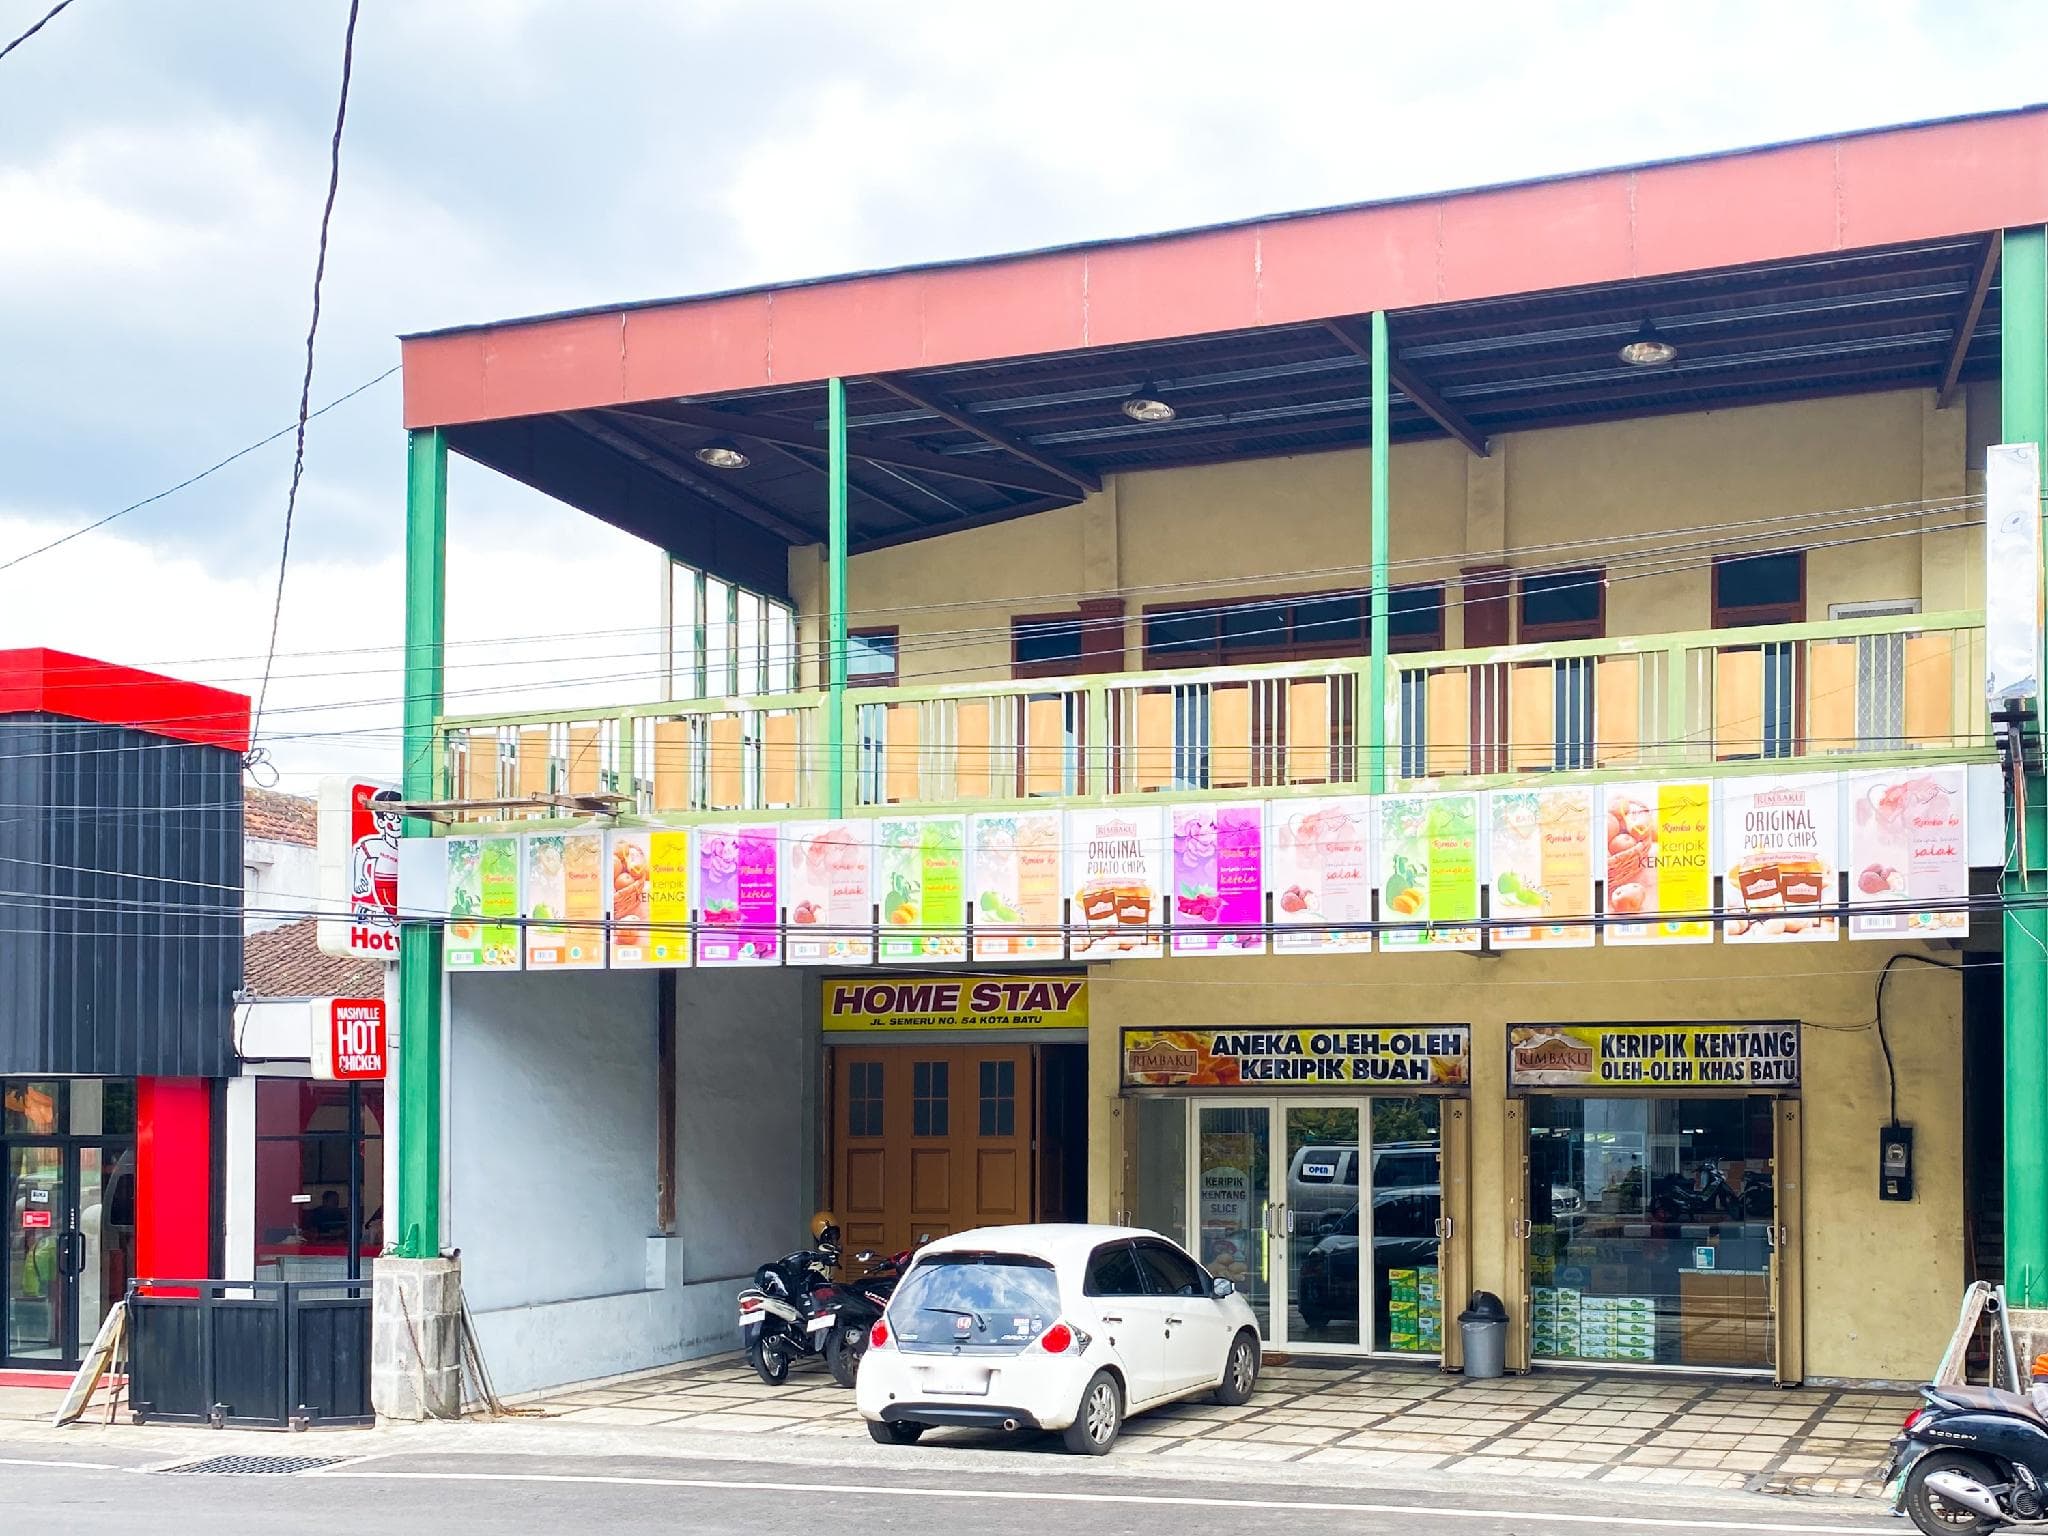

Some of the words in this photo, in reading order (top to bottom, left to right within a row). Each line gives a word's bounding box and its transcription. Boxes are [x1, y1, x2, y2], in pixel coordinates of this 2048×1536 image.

[1745, 809, 1816, 831] ORIGINAL
[1662, 840, 1705, 853] keripik
[1744, 833, 1783, 849] POTATO
[1787, 831, 1817, 848] CHIPS
[1088, 840, 1145, 859] ORIGINAL
[1911, 844, 1958, 858] salak
[1087, 860, 1119, 874] POTATO
[1121, 860, 1146, 874] CHIPS
[1638, 854, 1706, 868] KENTANG
[1326, 867, 1362, 881] salak
[635, 891, 686, 902] KENTANG
[832, 984, 961, 1015] HOME
[970, 982, 1084, 1013] STAY
[336, 1007, 380, 1020] NASHVILLE
[889, 1016, 936, 1025] SEMERU
[938, 1016, 958, 1025] NO.
[961, 1016, 977, 1025] 54
[979, 1016, 1010, 1024] KOTA
[1012, 1015, 1043, 1024] BATU
[337, 1020, 381, 1055] HOT
[1601, 1034, 1688, 1058] KERIPIK
[1694, 1031, 1796, 1058] KENTANG
[1210, 1033, 1304, 1057] ANEKA
[1310, 1033, 1461, 1056] OLEH-OLEH
[338, 1055, 382, 1073] CHICKEN
[1132, 1054, 1195, 1067] RIMBAKU
[1518, 1051, 1589, 1067] RIMBAKU
[1240, 1058, 1344, 1081] KERIPIK
[1352, 1058, 1431, 1081] BUAH
[1601, 1060, 1693, 1081] OLEH-OLEH
[1699, 1061, 1745, 1081] KHAS
[1750, 1060, 1796, 1081] BATU
[1308, 1166, 1329, 1175] OPEN
[1205, 1176, 1243, 1187] KERIPIK
[1201, 1190, 1246, 1200] KENTANG
[1210, 1203, 1238, 1213] SLICE
